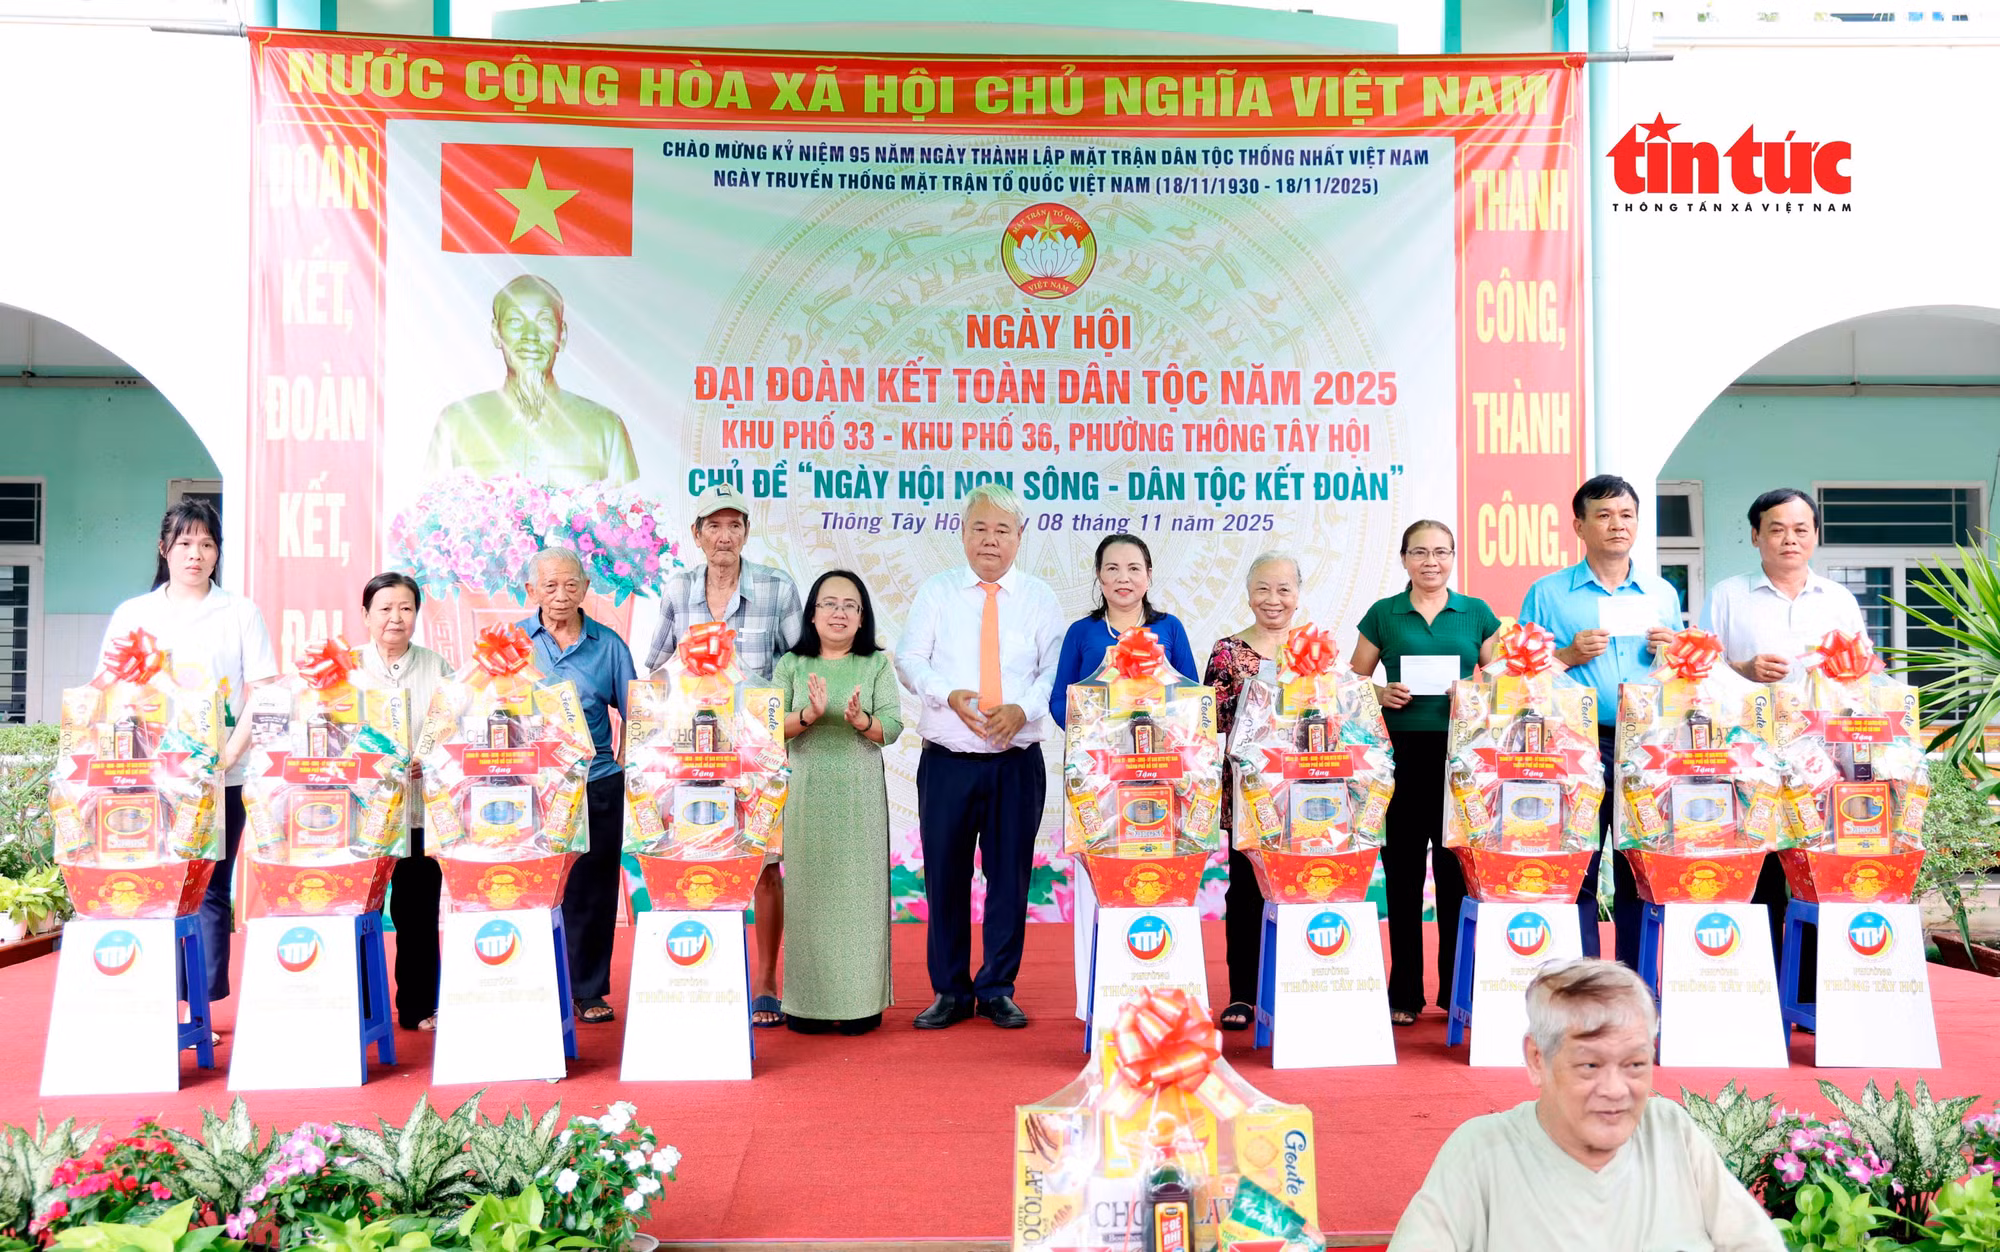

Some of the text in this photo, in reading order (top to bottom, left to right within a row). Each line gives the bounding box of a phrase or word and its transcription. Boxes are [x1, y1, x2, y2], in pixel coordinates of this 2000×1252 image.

[288, 48, 1548, 125] NƯỚC CỘNG HÒA XÃ HỘI CHỦ NGHĨA VIỆT NAM
[269, 132, 368, 210] ĐOÀN
[663, 139, 1429, 170] CHÀO MỪNG KỶ NIỆM 95 NĂM NGÀY THÀNH LẬP MẶT TRẬN DÂN TỘC THỐNG NHẤT VIỆT NAM
[714, 170, 761, 188] NGÀY
[767, 168, 833, 189] TRUYỀN
[839, 169, 896, 191] THỐNG
[901, 173, 937, 194] MẶT
[943, 174, 988, 194] TRẬN
[993, 170, 1013, 191] TỔ
[1018, 172, 1064, 192] QUỐC
[1069, 173, 1106, 196] VIỆT
[1111, 177, 1150, 193] NAM
[1156, 177, 1259, 195] (18/11/1930
[1276, 177, 1378, 195] 18/11/2025)
[1064, 214, 1083, 231] QUỐC
[282, 238, 354, 332] KẾT,
[1028, 281, 1069, 292] VIỆT NAM
[966, 307, 1131, 357] NGÀY HỘI
[695, 357, 1397, 413] ĐẠI ĐOÀN KẾT TOÀN DÂN TỘC NĂM 2025
[1472, 157, 1570, 567] THÀNH CÔNG, THÀNH CÔNG,
[265, 363, 367, 442] ĐOÀN
[723, 420, 779, 450] KHU
[784, 412, 835, 450] PHỐ
[843, 420, 874, 450] 33
[902, 421, 955, 451] KHU
[962, 412, 1013, 451] PHỐ
[1021, 421, 1060, 456] 36,
[1070, 415, 1174, 452] PHƯỜNG
[1179, 417, 1266, 452] THÔNG
[1272, 417, 1321, 452] TÂY
[1328, 417, 1370, 457] HỘI
[753, 459, 787, 497] ĐỀ
[899, 464, 944, 505] HỘI
[1024, 465, 1098, 500] SÔNG
[1129, 465, 1175, 500] DÂN
[1194, 466, 1245, 507] TỘC
[1256, 463, 1300, 500] KẾT
[279, 471, 350, 567] KẾT,
[821, 513, 883, 534] Thông
[892, 513, 927, 534] Tây
[1038, 514, 1062, 530] 08
[1072, 513, 1130, 534] tháng
[1141, 515, 1161, 531] 11
[1172, 515, 1214, 531] năm
[1222, 514, 1274, 531] 2025
[1281, 976, 1380, 992] THÔNG TÂY HỘI
[1824, 978, 1924, 994] THÔNG TÂY HỘI
